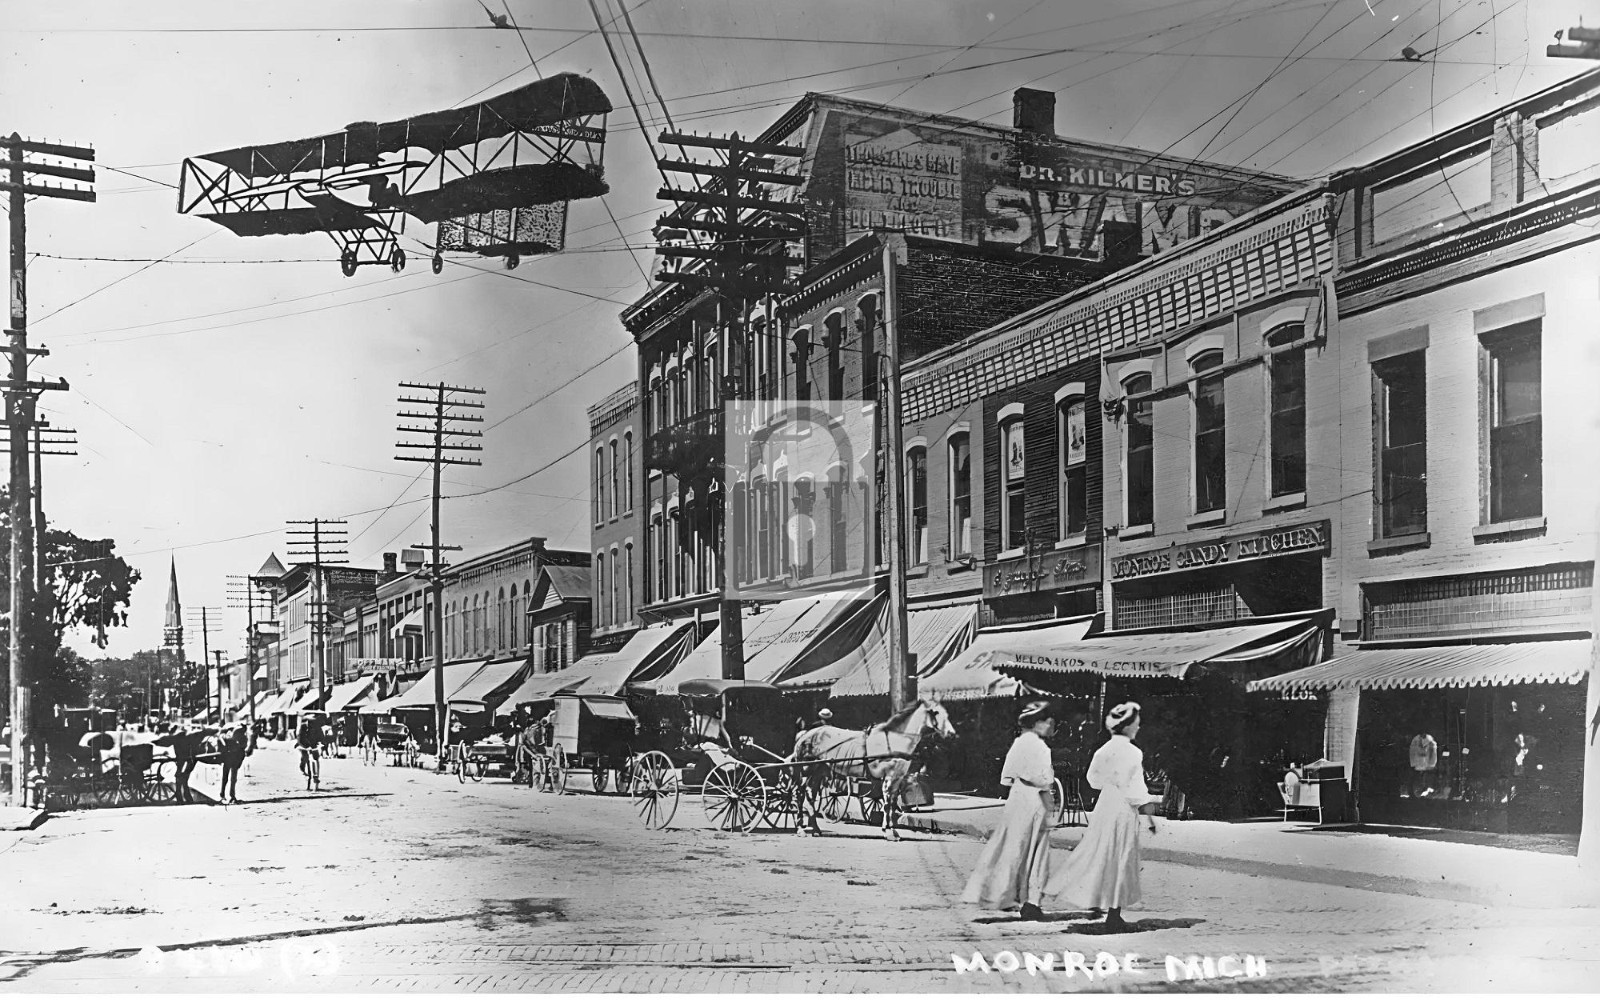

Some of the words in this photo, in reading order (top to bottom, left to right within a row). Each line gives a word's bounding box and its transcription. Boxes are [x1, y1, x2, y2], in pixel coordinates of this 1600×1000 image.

[1070, 166, 1196, 196] KILMER'S
[1176, 541, 1233, 569] CANDY
[1237, 525, 1326, 560] KITCHEN
